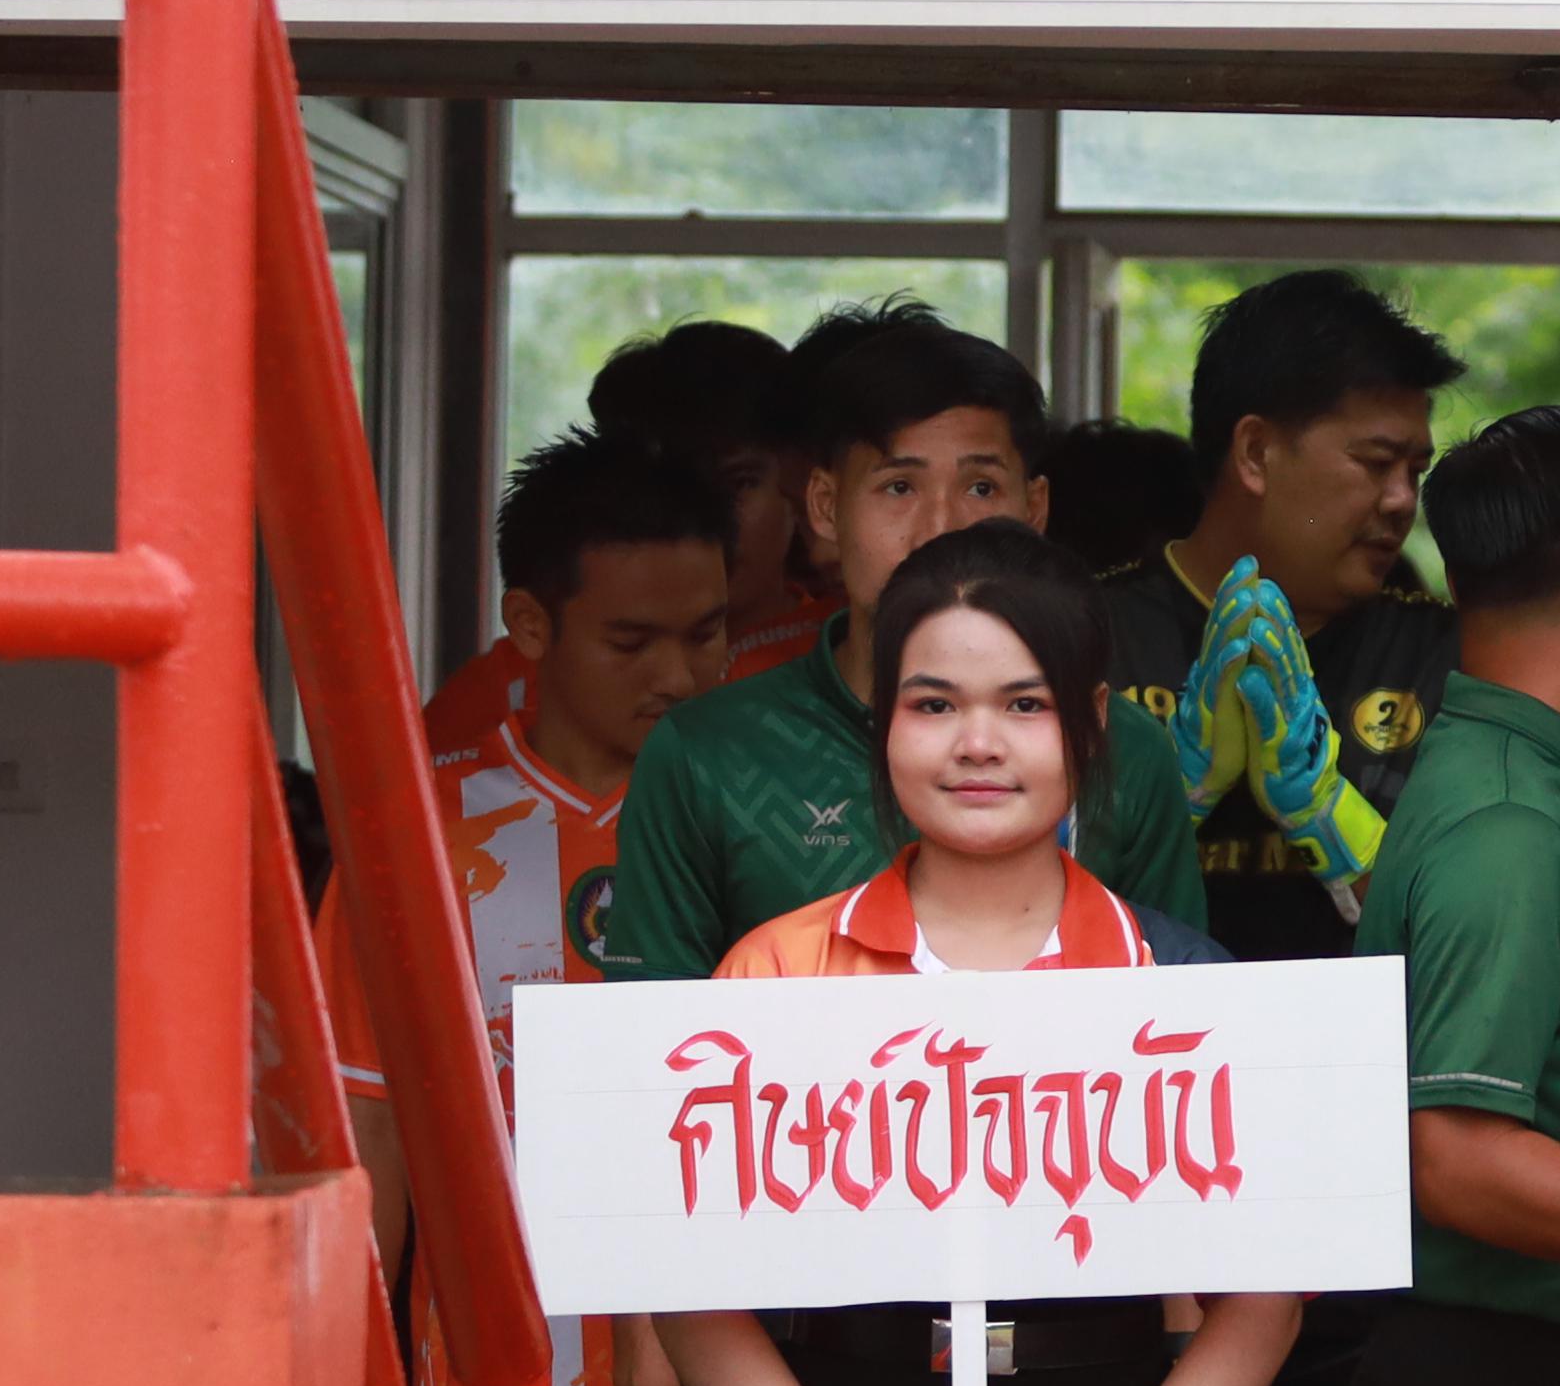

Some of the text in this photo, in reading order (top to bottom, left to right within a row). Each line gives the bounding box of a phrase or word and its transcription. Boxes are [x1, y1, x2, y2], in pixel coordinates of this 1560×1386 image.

[664, 1018, 1244, 1268] ศิษย์ปัจจุบัน
